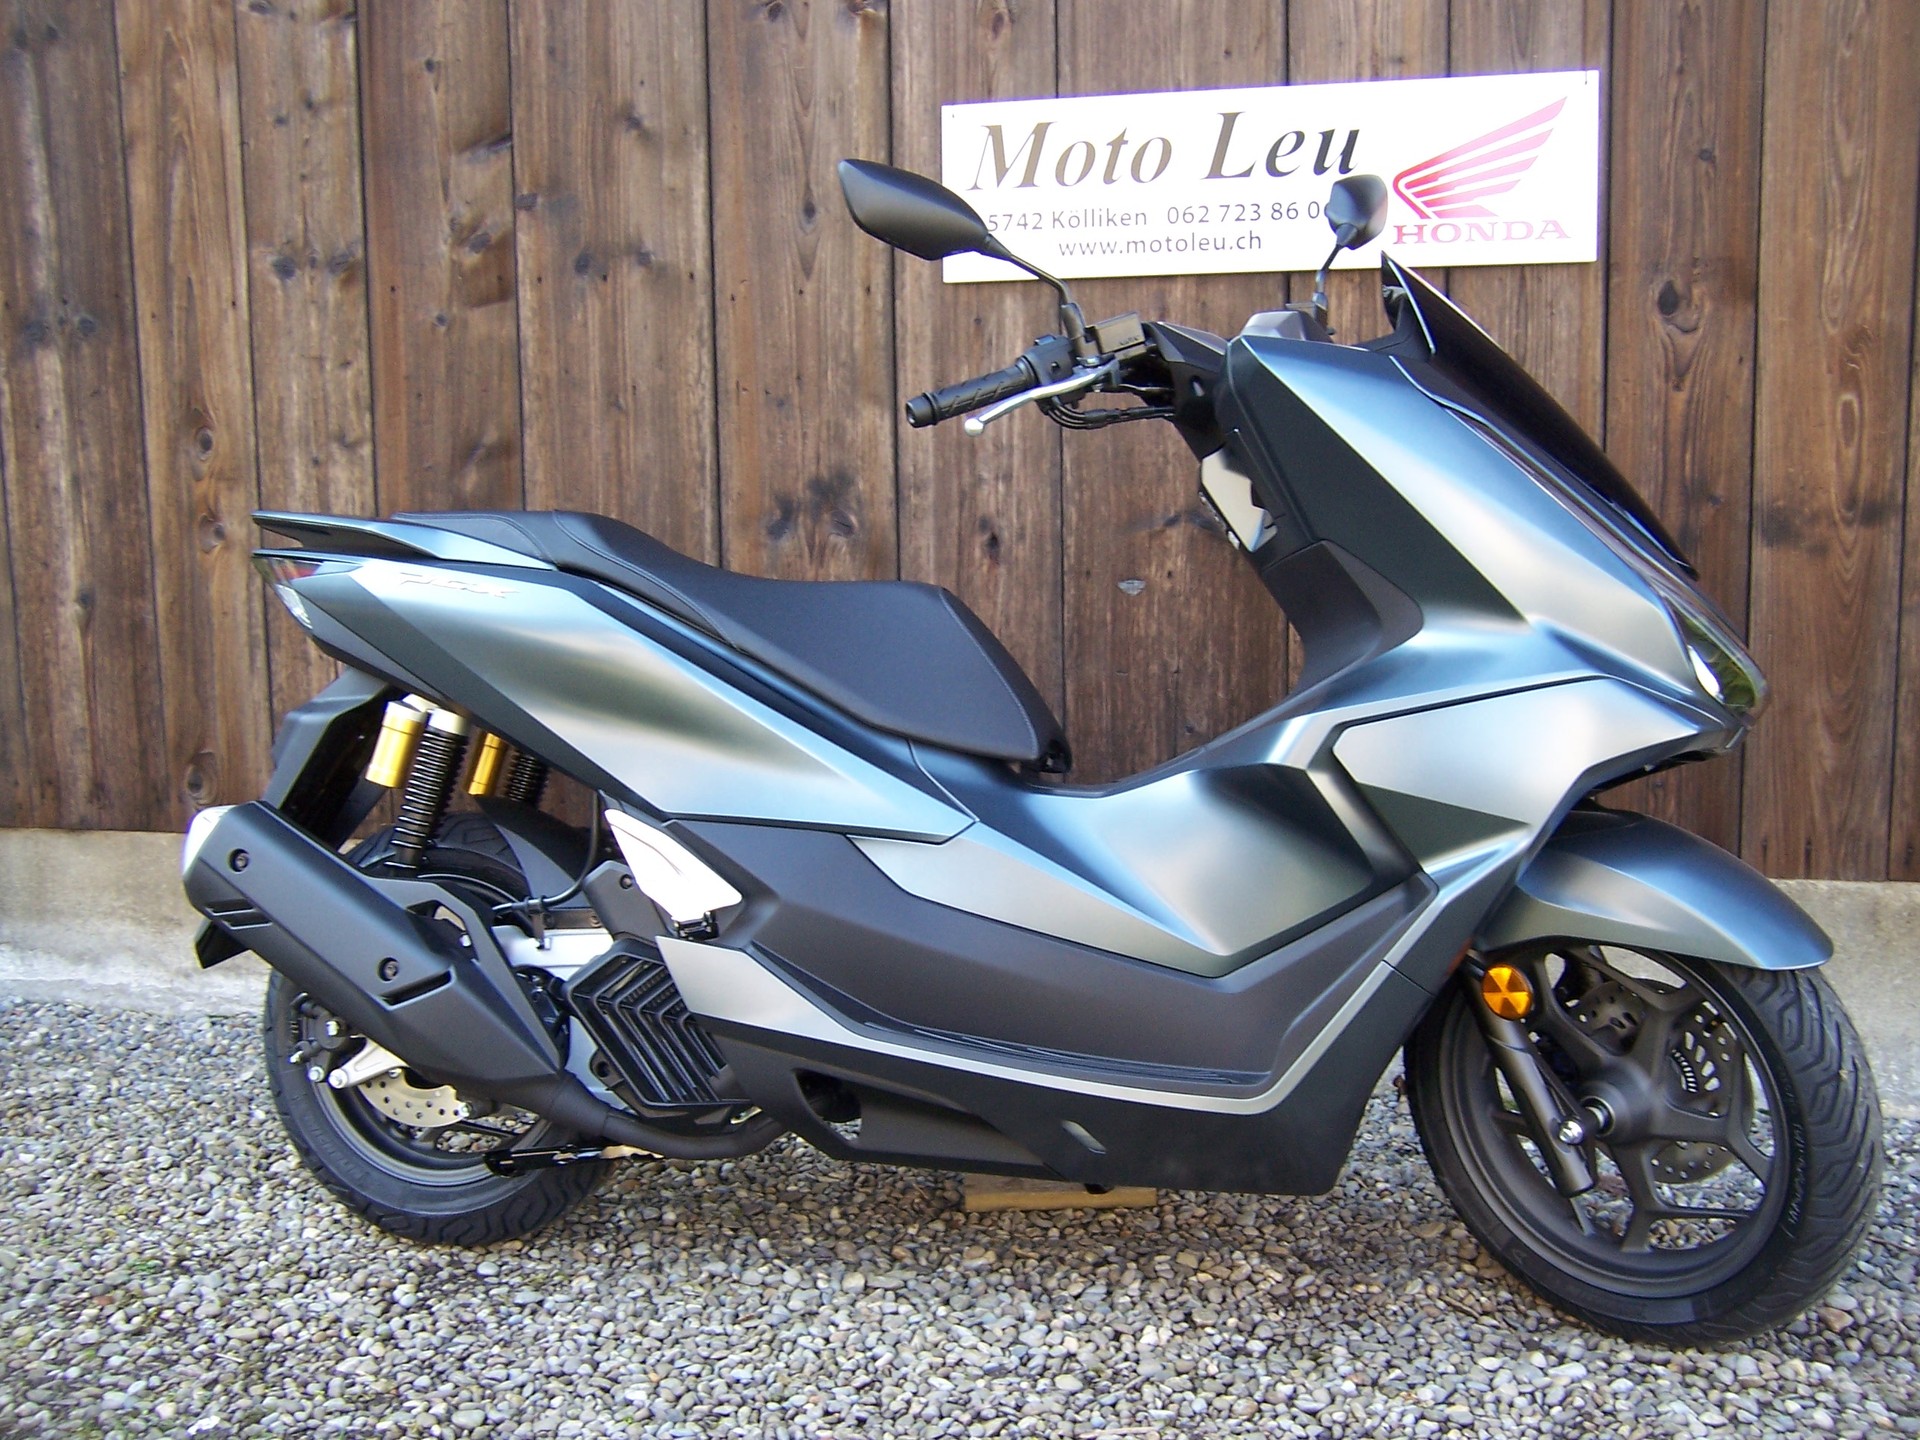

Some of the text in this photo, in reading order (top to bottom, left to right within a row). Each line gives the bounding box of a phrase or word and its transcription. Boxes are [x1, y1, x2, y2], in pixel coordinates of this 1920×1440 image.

[965, 111, 1360, 191] Moto Leu
[988, 212, 1043, 232] 5742
[1052, 208, 1147, 229] Kölliken
[1167, 205, 1209, 224] 062
[1219, 203, 1261, 222] 723
[1271, 202, 1299, 220] 86
[1058, 230, 1262, 256] www.motoleu.ch
[1393, 219, 1572, 245] HONDA
